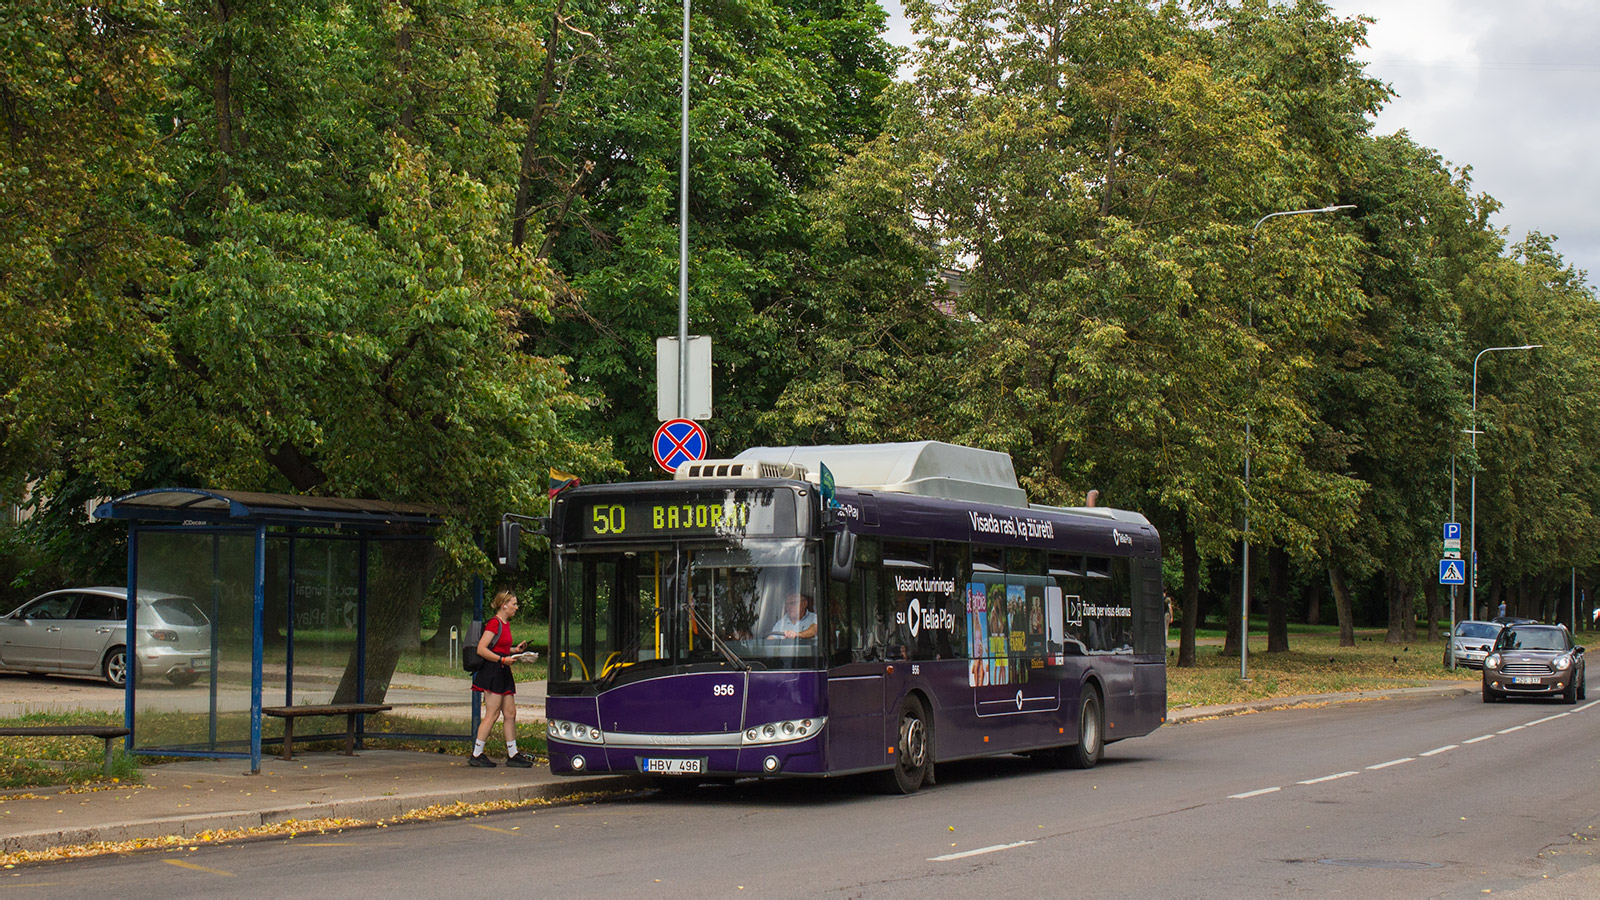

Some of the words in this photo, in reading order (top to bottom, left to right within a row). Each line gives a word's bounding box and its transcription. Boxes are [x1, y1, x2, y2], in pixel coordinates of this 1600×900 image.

[593, 504, 626, 534] 50
[968, 511, 1000, 532] Visada
[1000, 516, 1017, 538] rasi,
[1016, 517, 1028, 541] ką
[1448, 525, 1458, 537] P
[895, 575, 923, 592] Vasarok
[896, 611, 906, 624] su
[921, 608, 939, 629] Telia
[939, 608, 956, 634] Play
[713, 684, 734, 696] 956
[650, 760, 672, 770] HBV
[679, 760, 698, 771] 496
